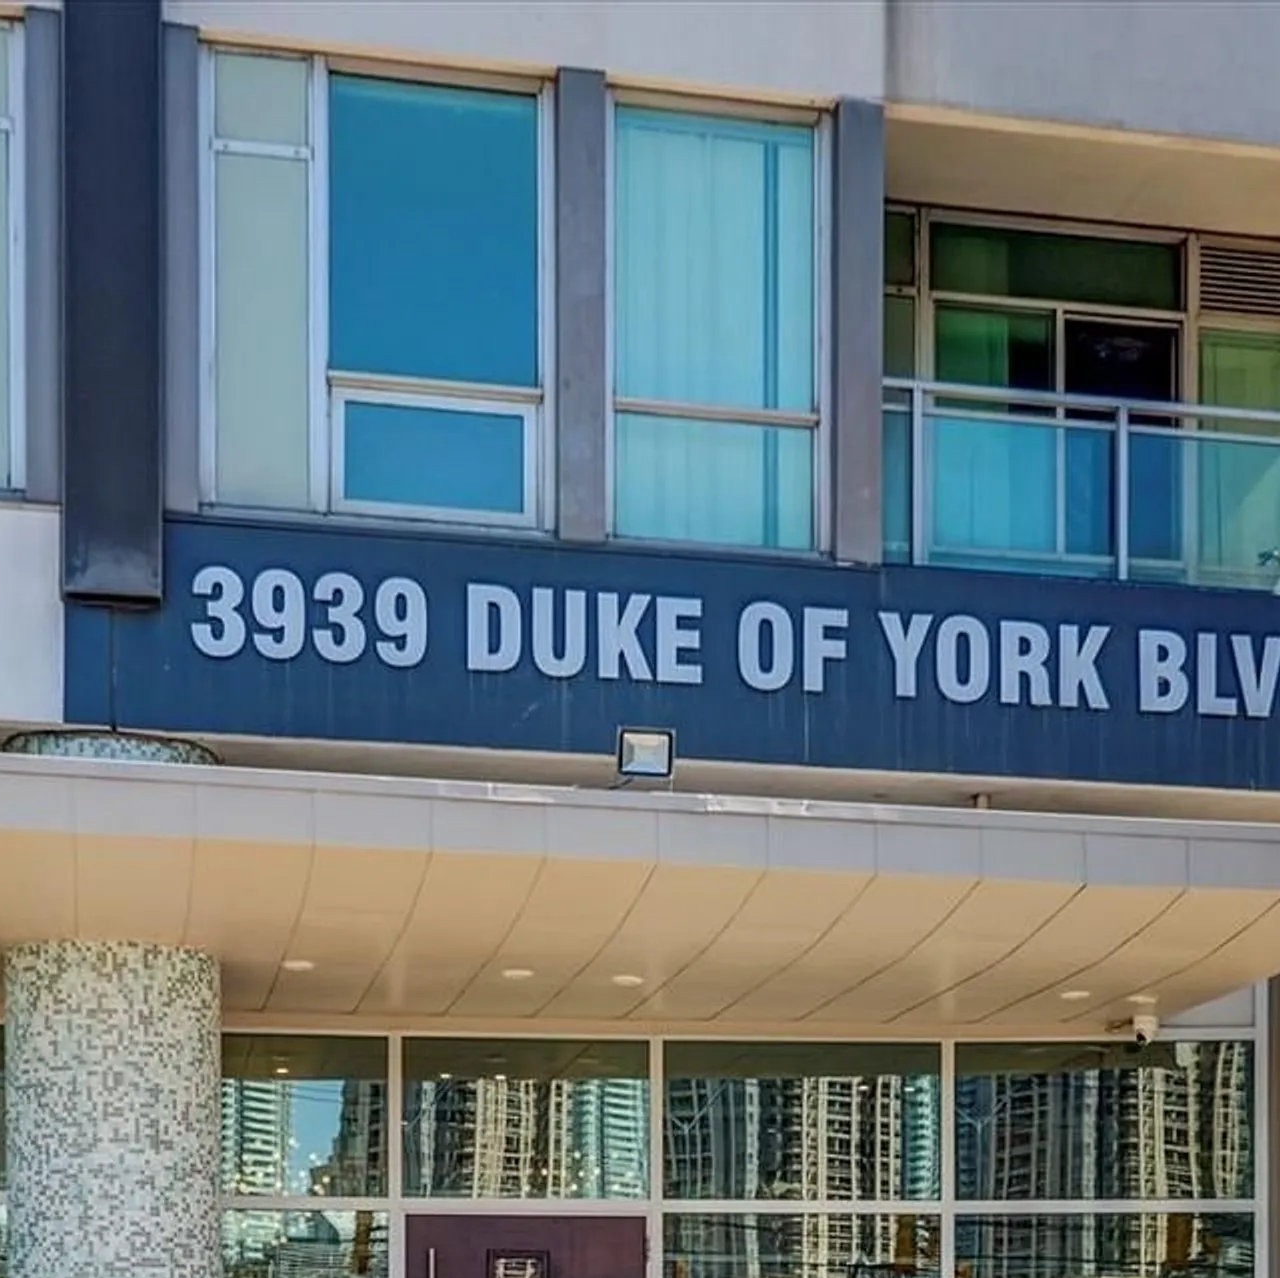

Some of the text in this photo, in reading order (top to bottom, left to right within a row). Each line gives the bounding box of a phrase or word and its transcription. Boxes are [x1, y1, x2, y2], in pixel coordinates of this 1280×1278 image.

[189, 565, 429, 668] 3939
[466, 582, 704, 685] DUKE
[737, 600, 850, 693] OF
[877, 610, 1112, 711] YORK
